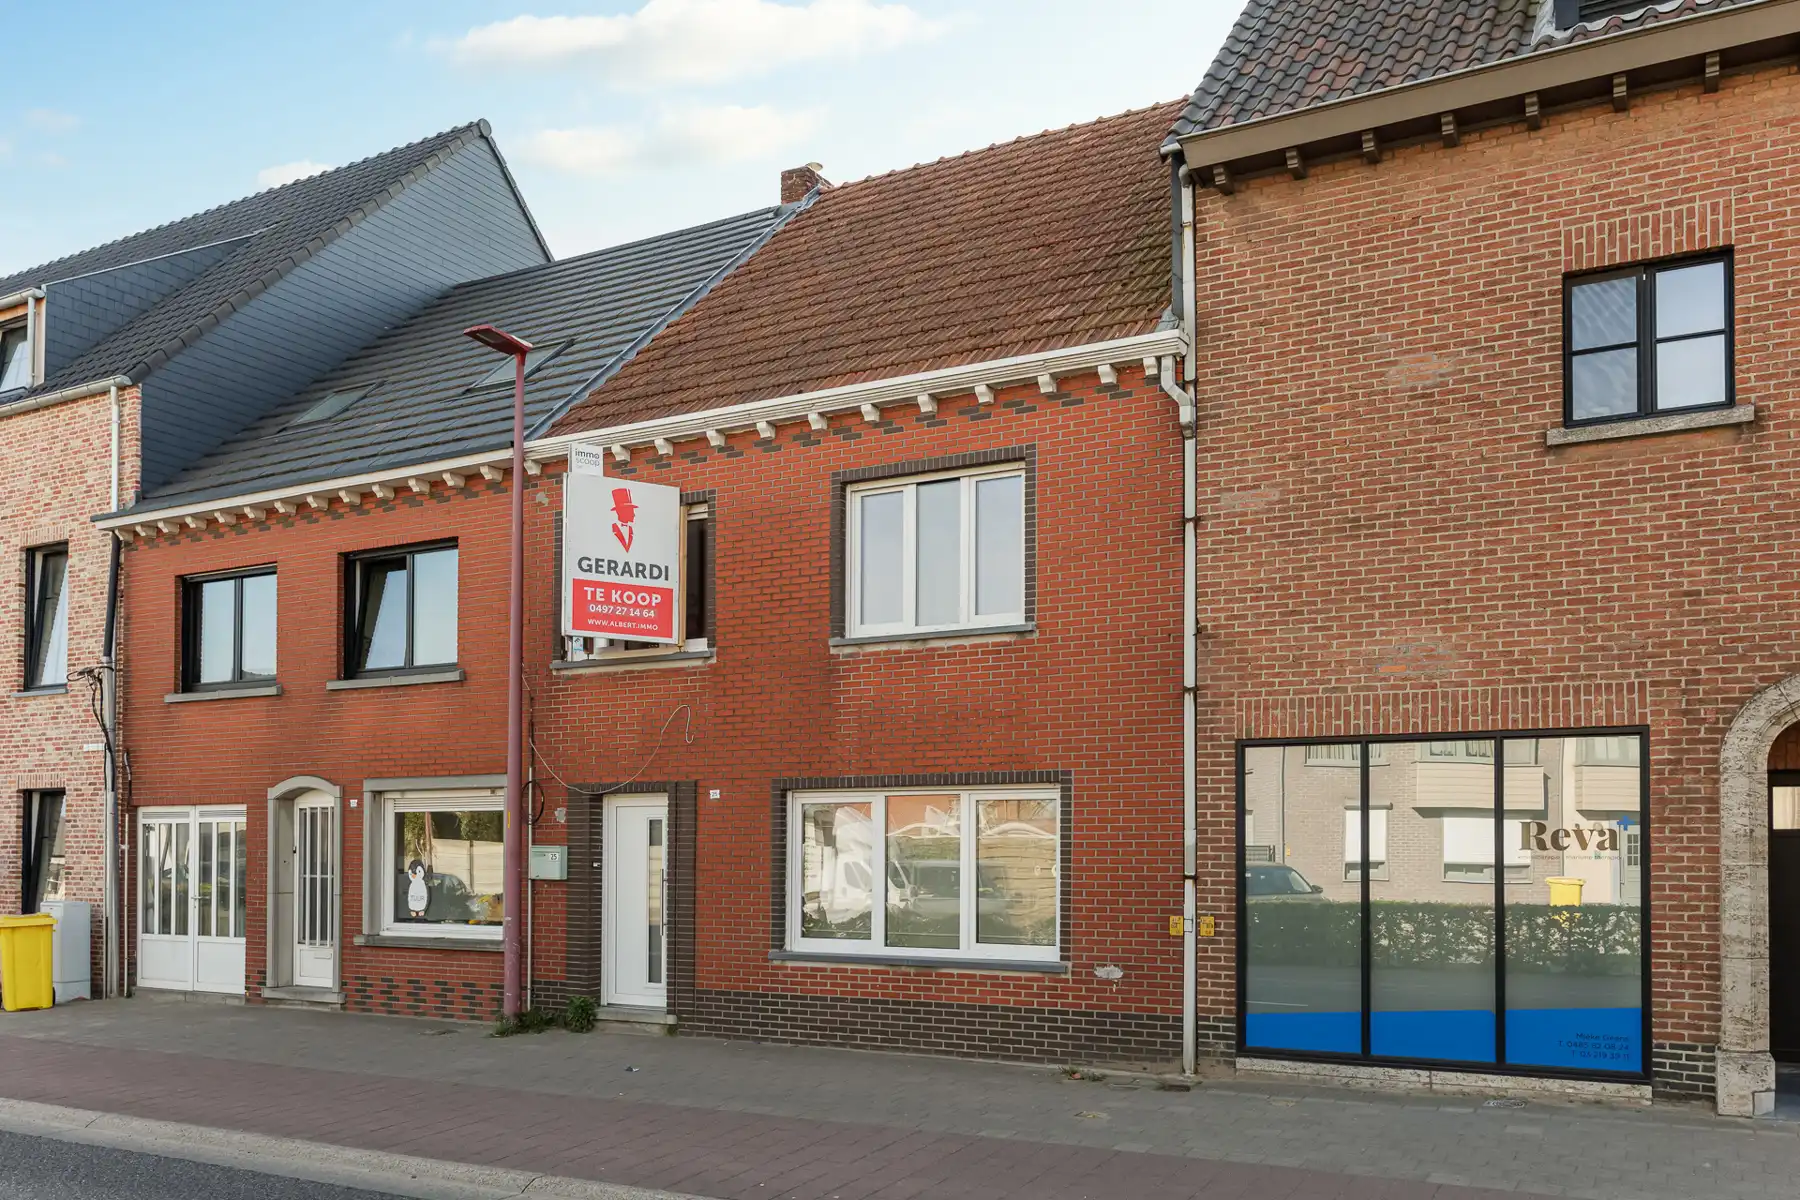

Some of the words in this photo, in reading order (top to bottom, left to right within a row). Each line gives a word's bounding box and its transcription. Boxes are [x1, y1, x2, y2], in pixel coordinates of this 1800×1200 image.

[575, 449, 600, 459] immo
[576, 458, 600, 467] scoop
[577, 556, 669, 581] GERARDI
[584, 586, 606, 602] TE
[611, 589, 662, 606] KOOP
[589, 604, 614, 614] 0497
[616, 606, 628, 615] 27
[630, 608, 640, 616] 14
[642, 609, 655, 618] 64
[588, 618, 658, 631] WWW.ALBERT.IMMO
